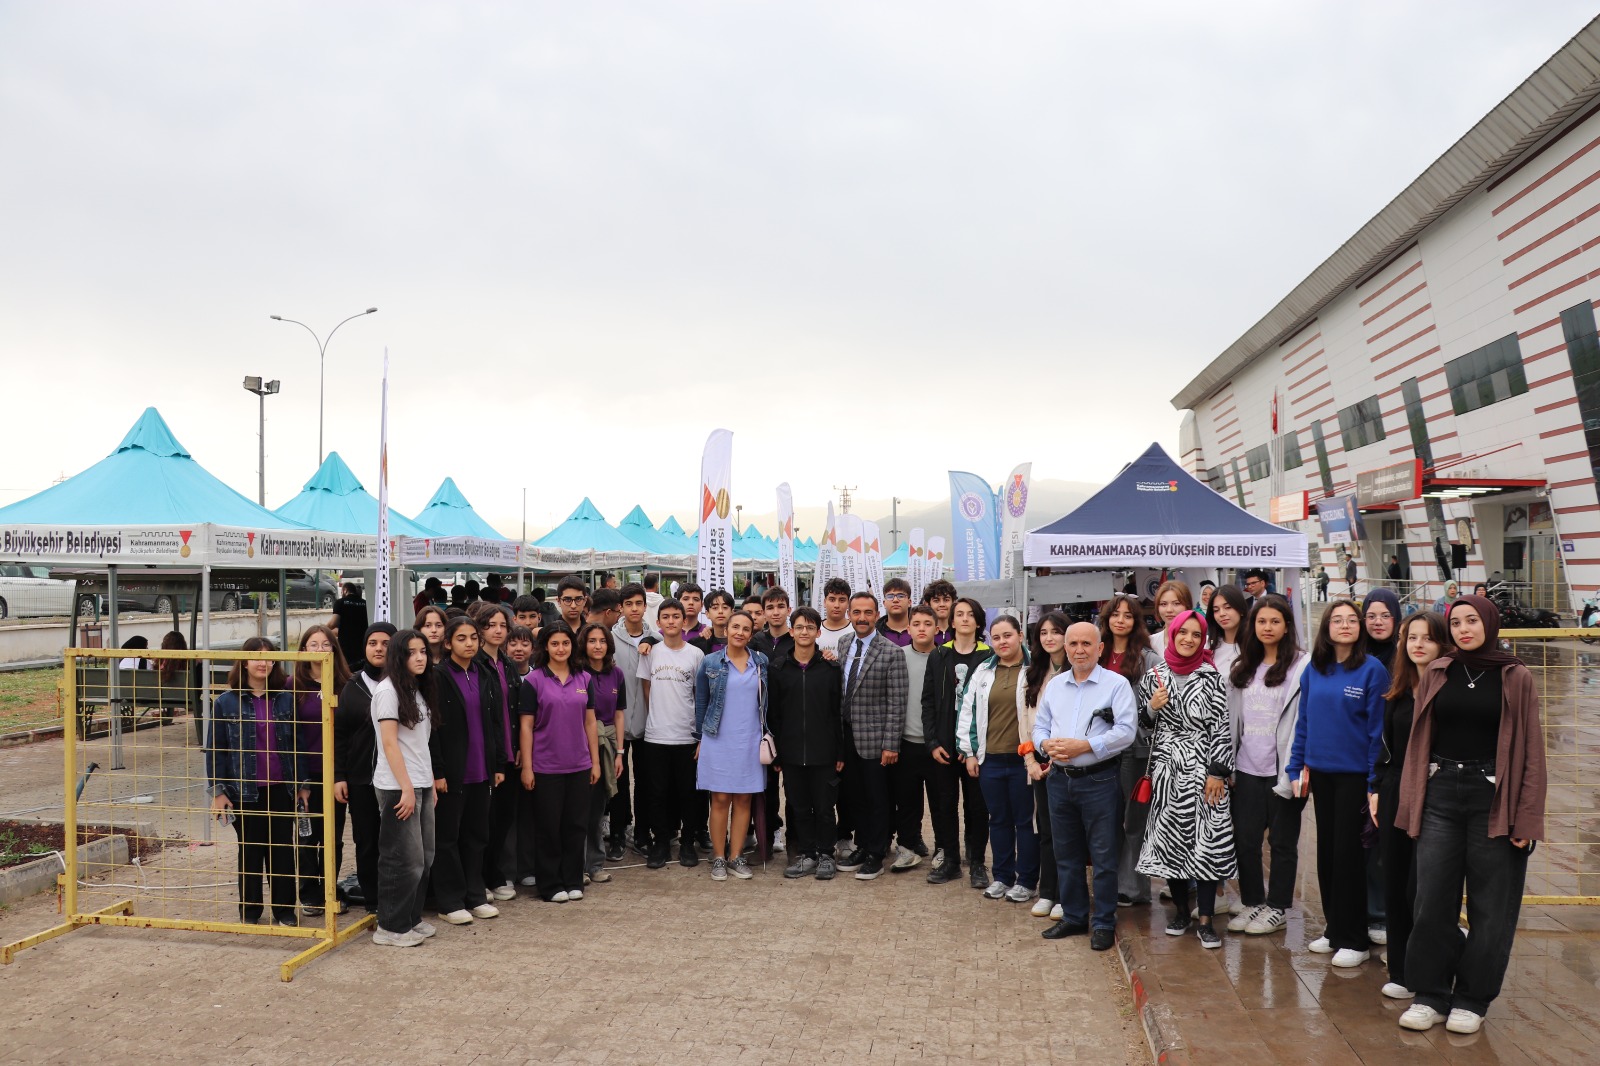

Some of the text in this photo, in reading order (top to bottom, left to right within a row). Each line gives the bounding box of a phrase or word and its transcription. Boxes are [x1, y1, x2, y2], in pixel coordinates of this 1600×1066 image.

[4, 530, 64, 557] Büyükşehir
[66, 530, 122, 559] Belediyesi
[130, 539, 179, 547] Kahramanmaraş
[260, 533, 310, 559] Kahramanmaraş
[310, 536, 341, 561] Büyükşehir
[1050, 542, 1277, 558] KAHRAMANMARAŞ BÜYÜKŞEHİR BELEDİYESİ
